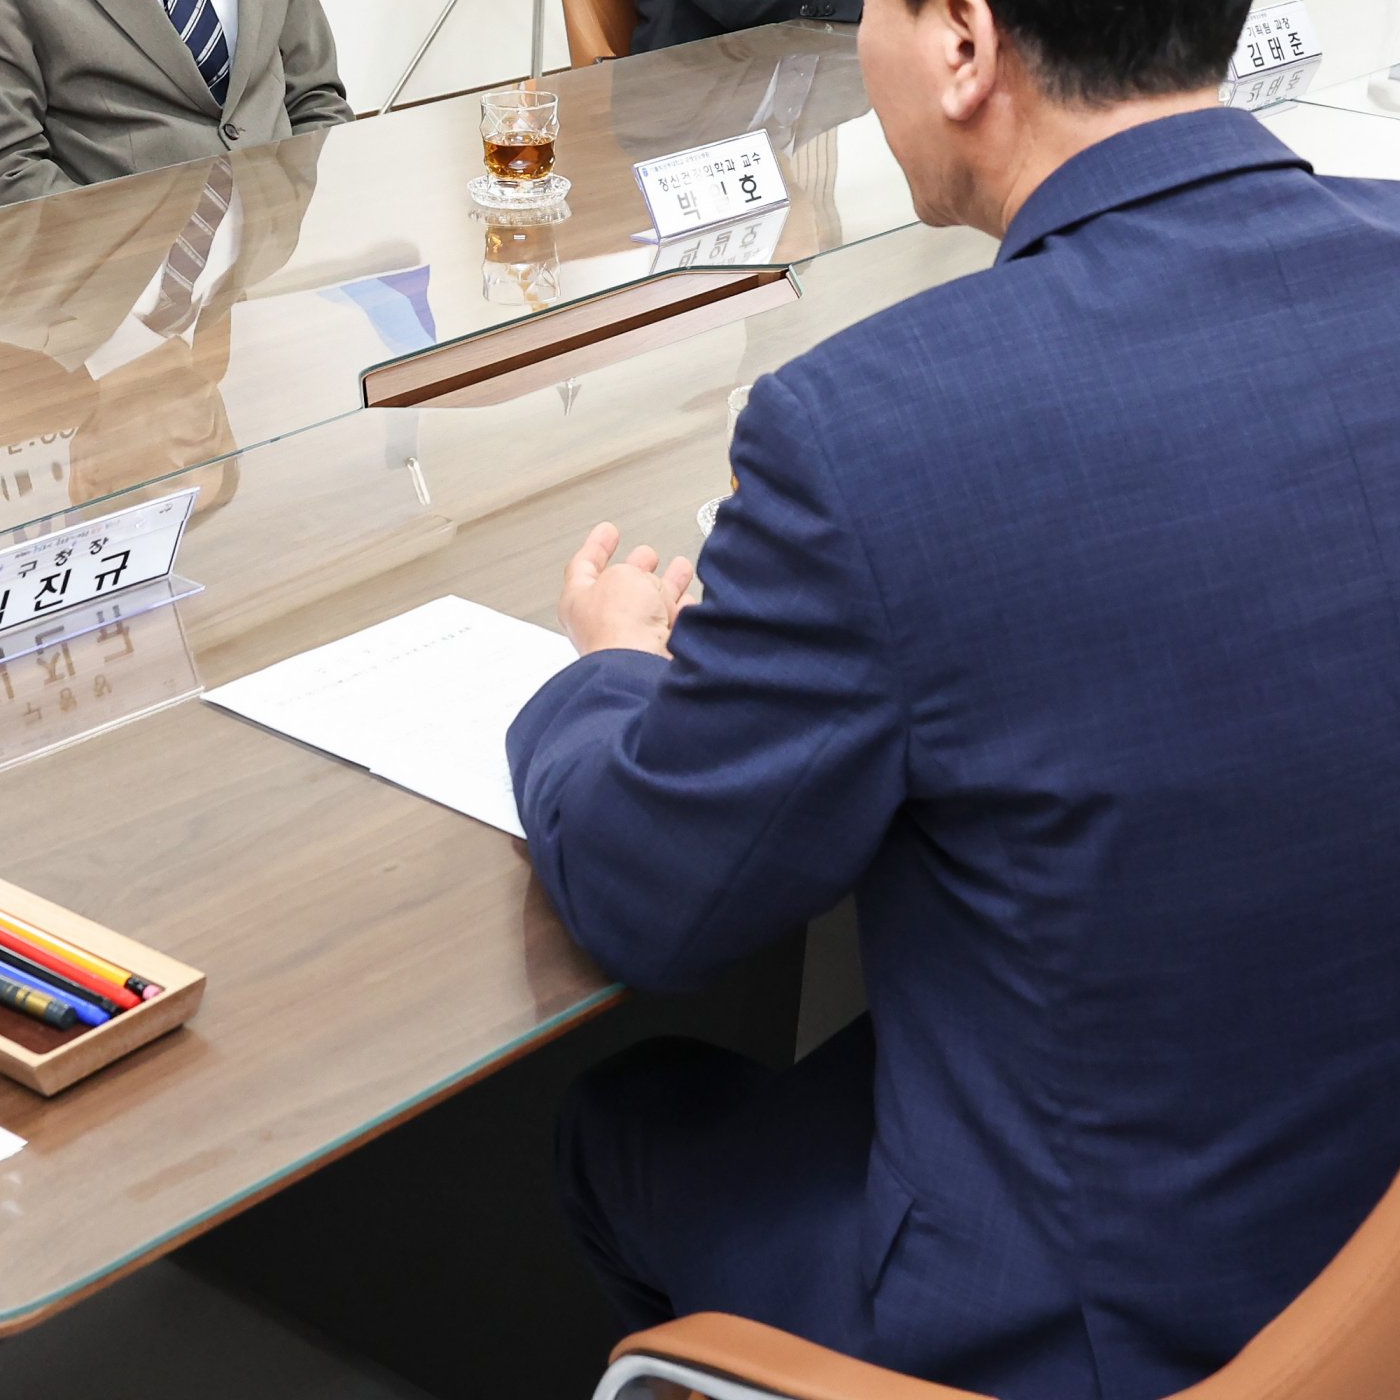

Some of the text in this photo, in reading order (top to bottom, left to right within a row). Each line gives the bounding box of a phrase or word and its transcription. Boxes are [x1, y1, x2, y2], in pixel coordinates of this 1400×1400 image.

[1247, 32, 1305, 68] 김태준
[658, 158, 736, 192] 정신건의학과
[741, 152, 761, 168] 교수
[18, 537, 110, 578] 구청장
